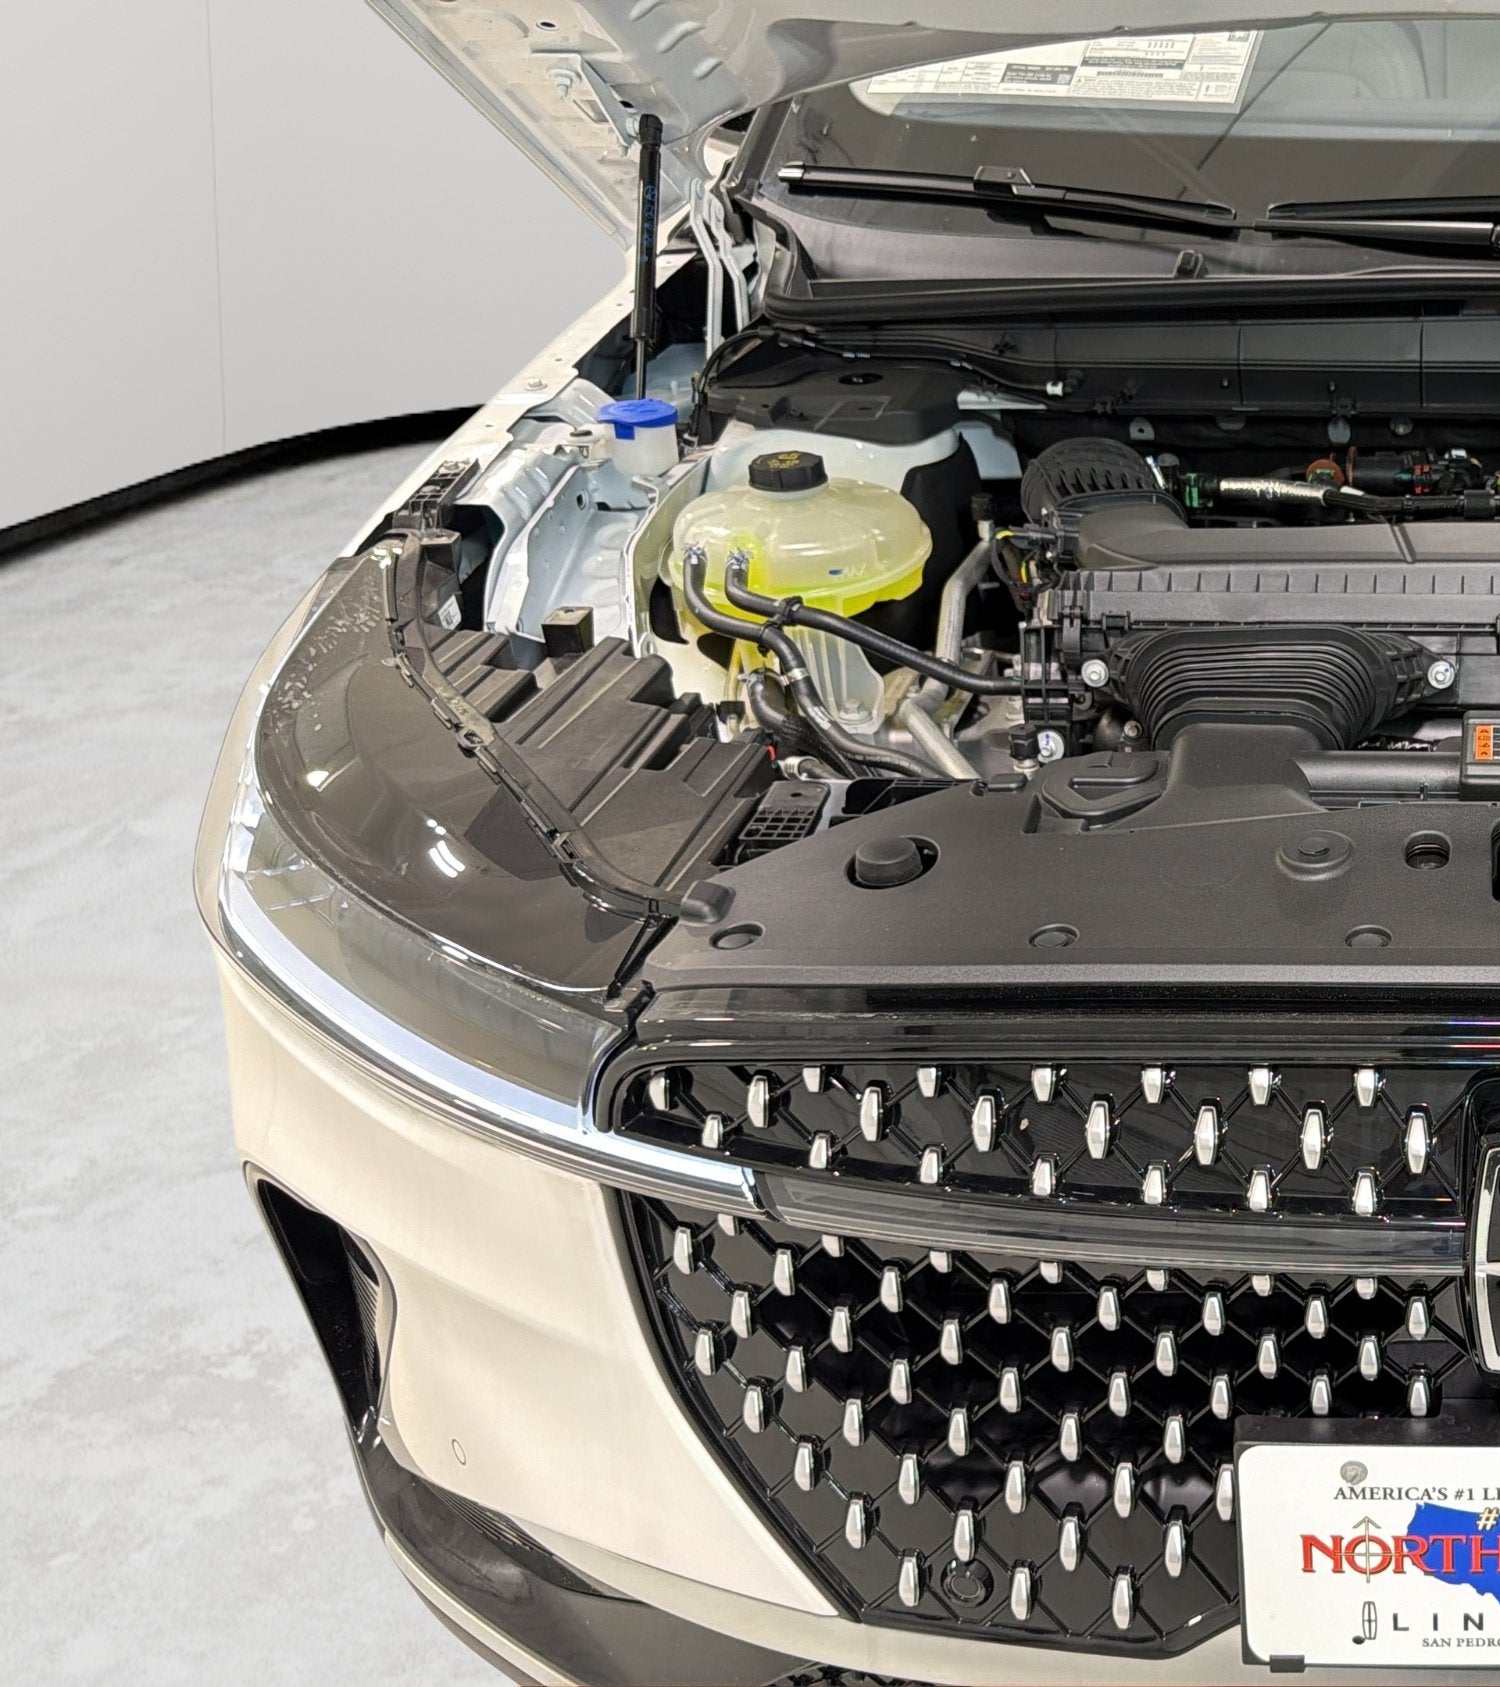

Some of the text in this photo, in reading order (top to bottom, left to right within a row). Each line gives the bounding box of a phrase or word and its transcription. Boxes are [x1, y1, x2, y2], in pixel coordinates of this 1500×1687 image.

[1334, 1486, 1448, 1501] AMERICA'S
[1454, 1488, 1474, 1501] #1
[1422, 1637, 1451, 1648] SAN
